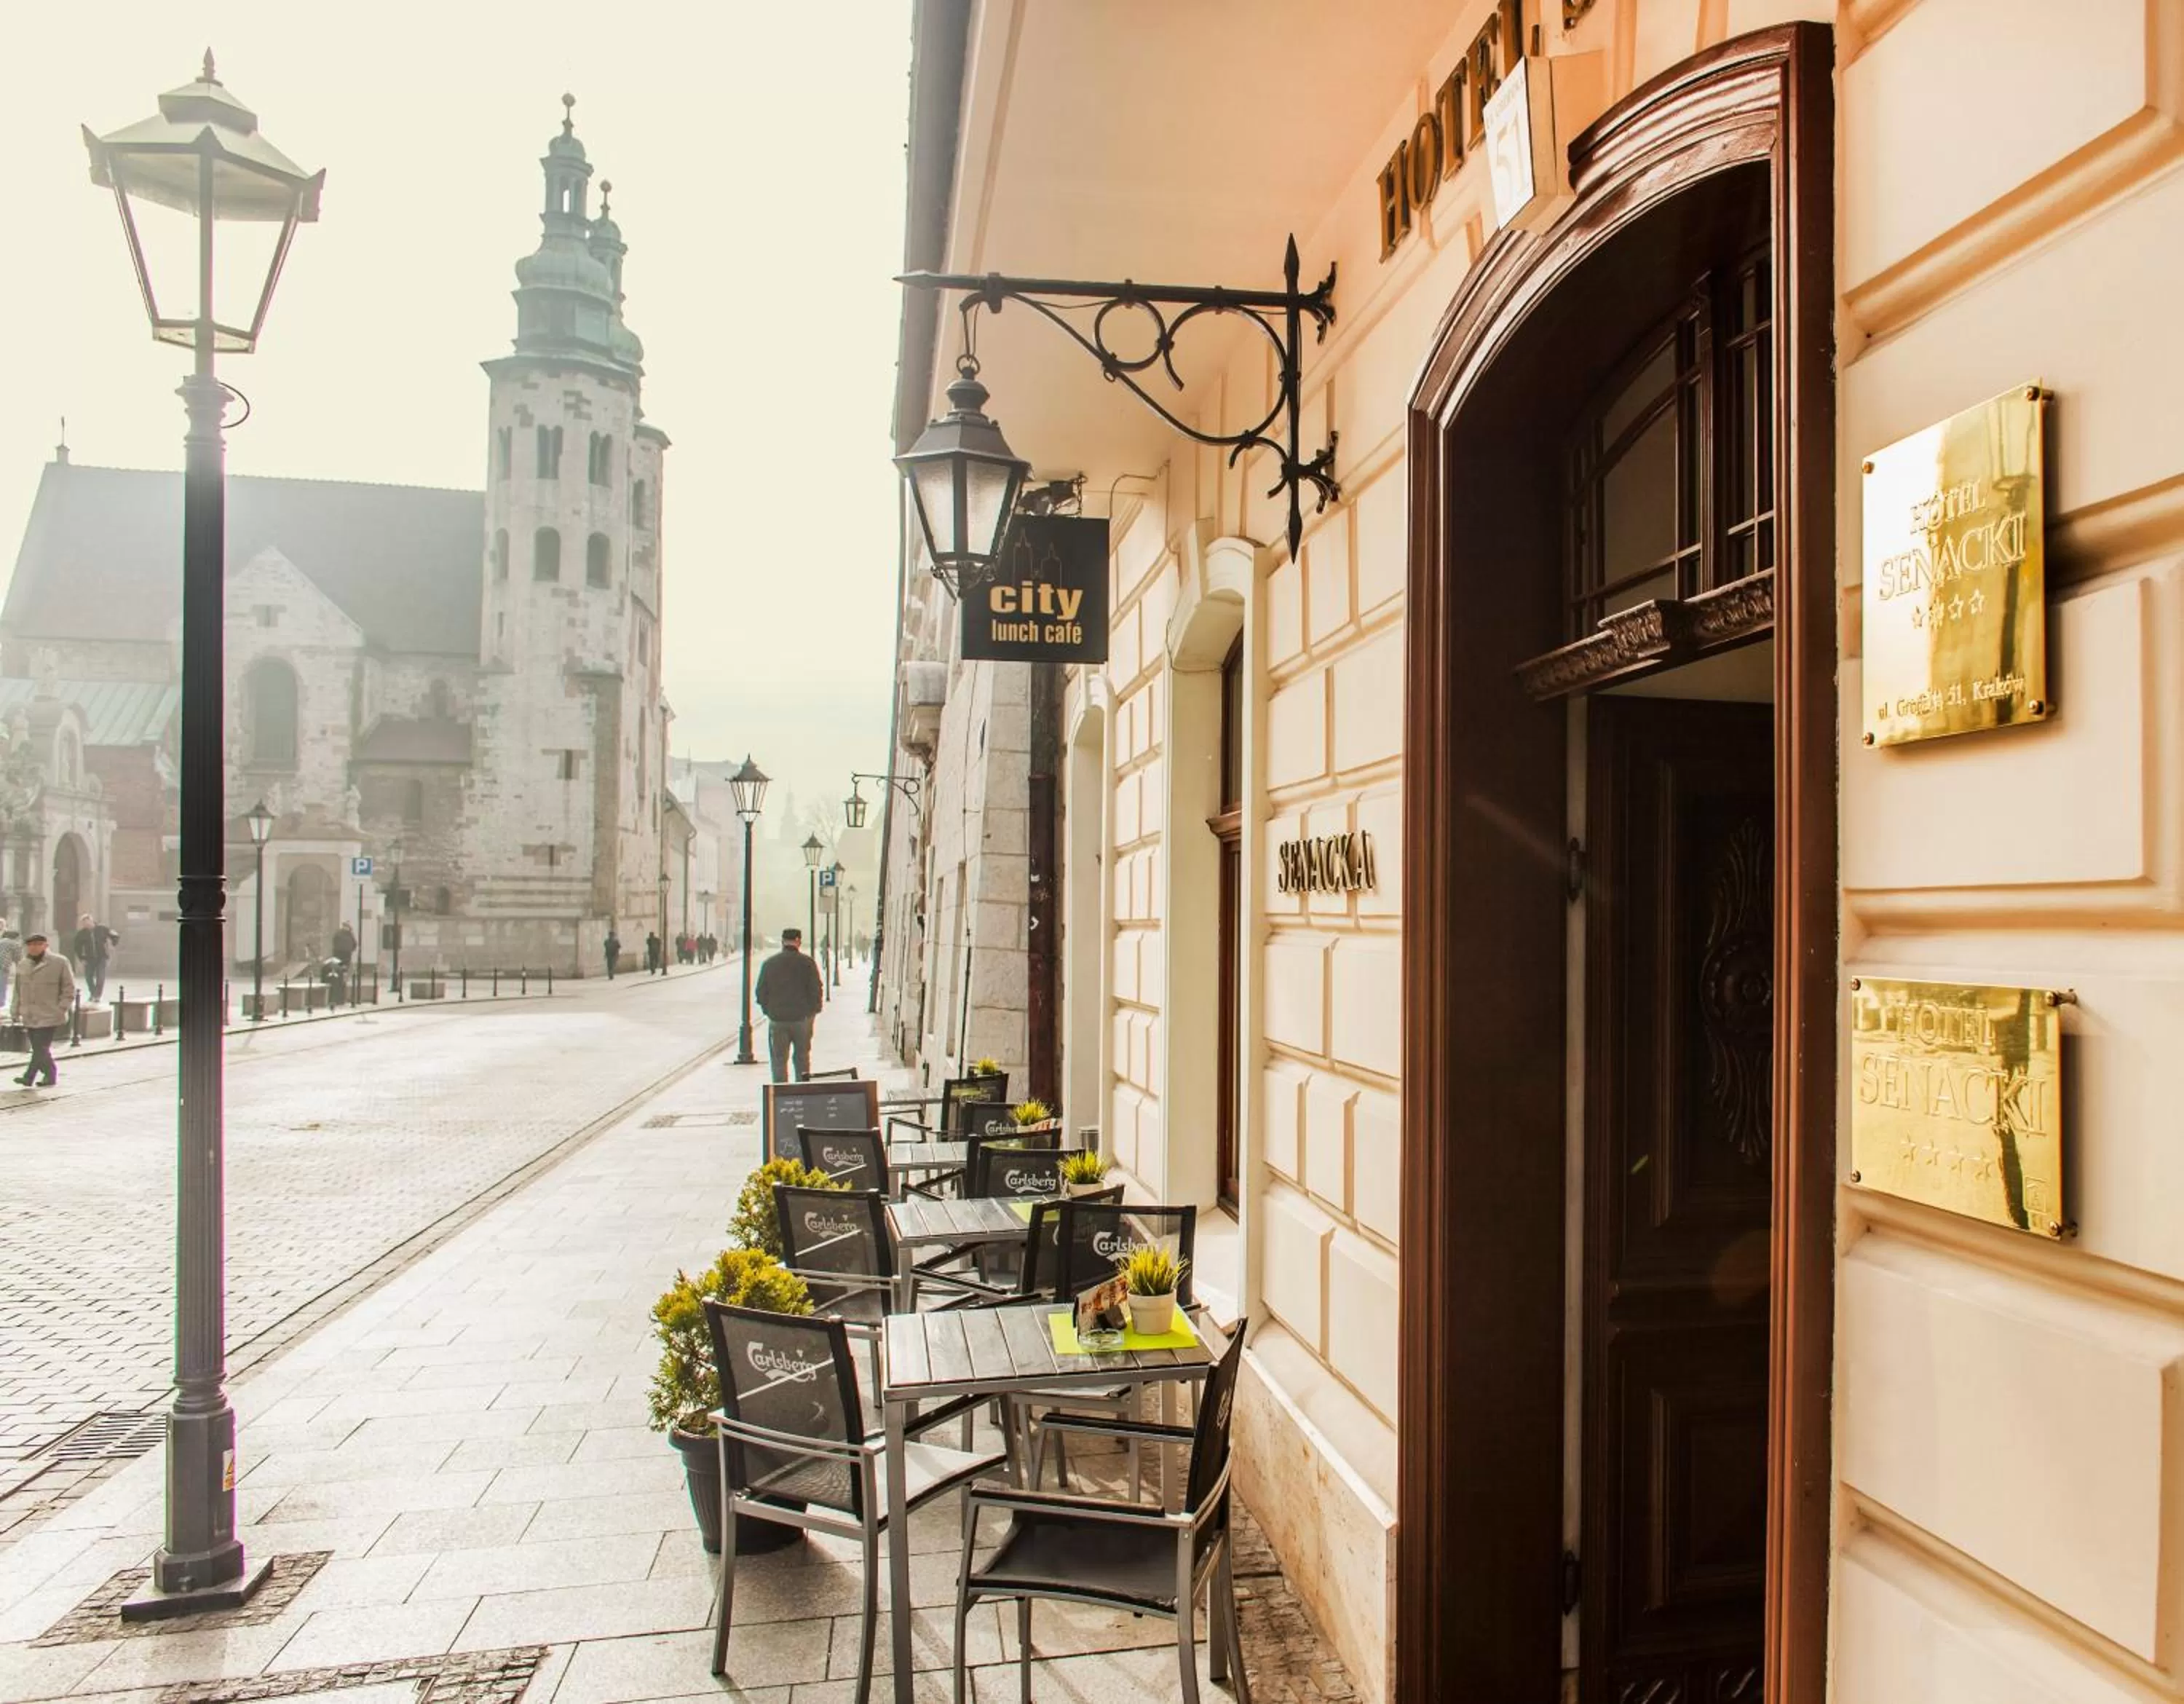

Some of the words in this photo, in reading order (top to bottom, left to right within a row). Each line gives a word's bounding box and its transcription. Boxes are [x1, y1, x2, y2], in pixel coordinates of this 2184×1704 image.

[1910, 480, 1987, 535] HOTEL
[1878, 510, 2027, 601] SENACKI
[990, 580, 1083, 620] city
[992, 620, 1038, 643] lunch
[355, 859, 368, 873] P
[822, 872, 833, 885] P
[1896, 1002, 1997, 1050] HOTEL
[1859, 1052, 2047, 1137] SENACKI
[823, 1147, 865, 1167] Carlsberg
[1005, 1169, 1056, 1194] Carlsberg
[747, 1341, 817, 1382] Carlsberg
